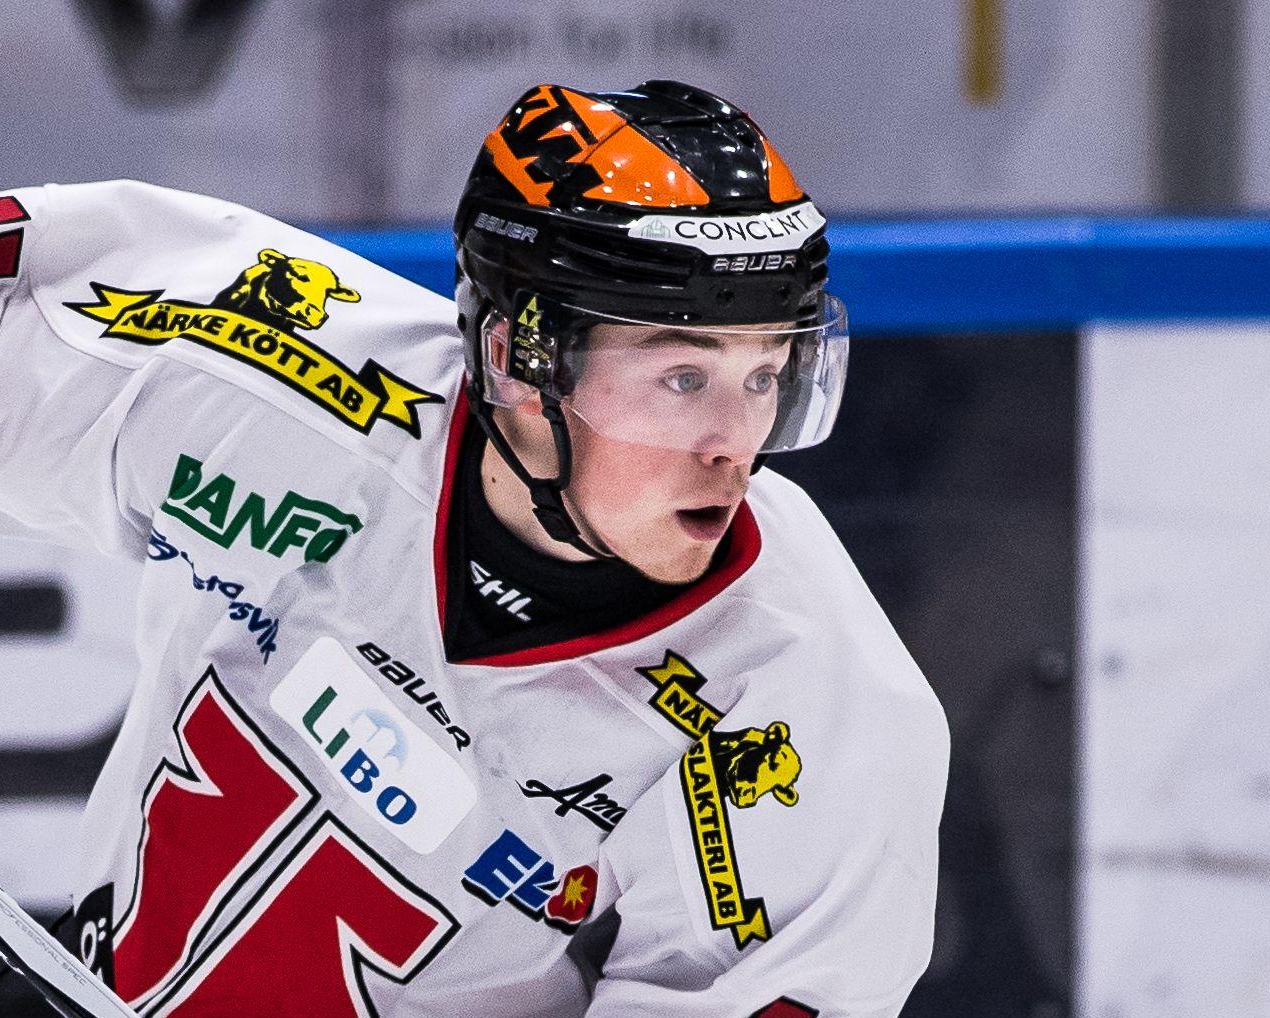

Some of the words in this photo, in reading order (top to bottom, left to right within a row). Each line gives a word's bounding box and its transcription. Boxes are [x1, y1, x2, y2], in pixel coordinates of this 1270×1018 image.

[499, 85, 606, 207] KTM
[474, 212, 539, 244] BAUER
[121, 303, 228, 336] NÄRKE
[227, 328, 320, 378] KÖTT
[316, 373, 364, 413] AB
[469, 559, 533, 623] SHL
[355, 641, 472, 752] BAUER
[301, 685, 418, 825] LIBO
[686, 741, 728, 875] SLAKTERI
[711, 879, 738, 921] AB
[61, 961, 88, 988] SPEC
